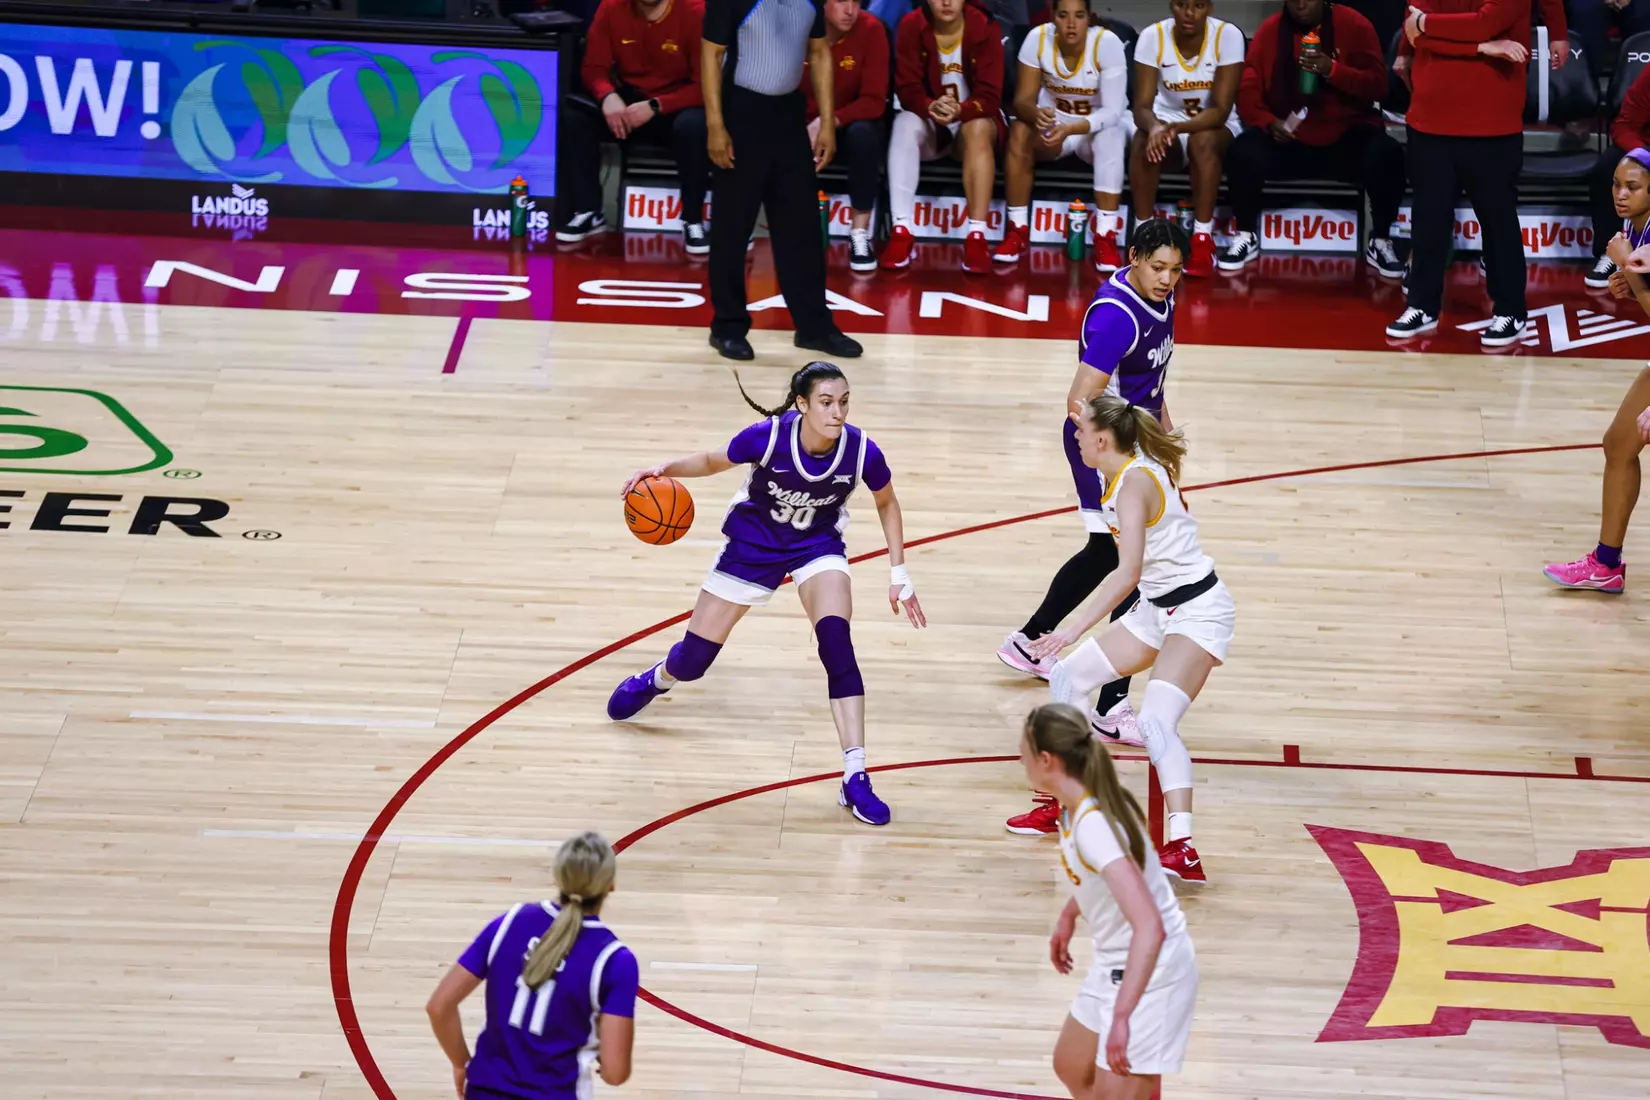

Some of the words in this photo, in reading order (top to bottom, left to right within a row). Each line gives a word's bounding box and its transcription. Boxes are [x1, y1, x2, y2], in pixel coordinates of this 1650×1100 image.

[191, 195, 269, 216] LANDUS
[473, 208, 549, 229] LANUS
[914, 202, 1001, 234] HyVe
[1264, 214, 1355, 246] HyVee
[1522, 222, 1593, 253] yVee
[770, 501, 817, 531] 30
[508, 975, 556, 1037] 11
